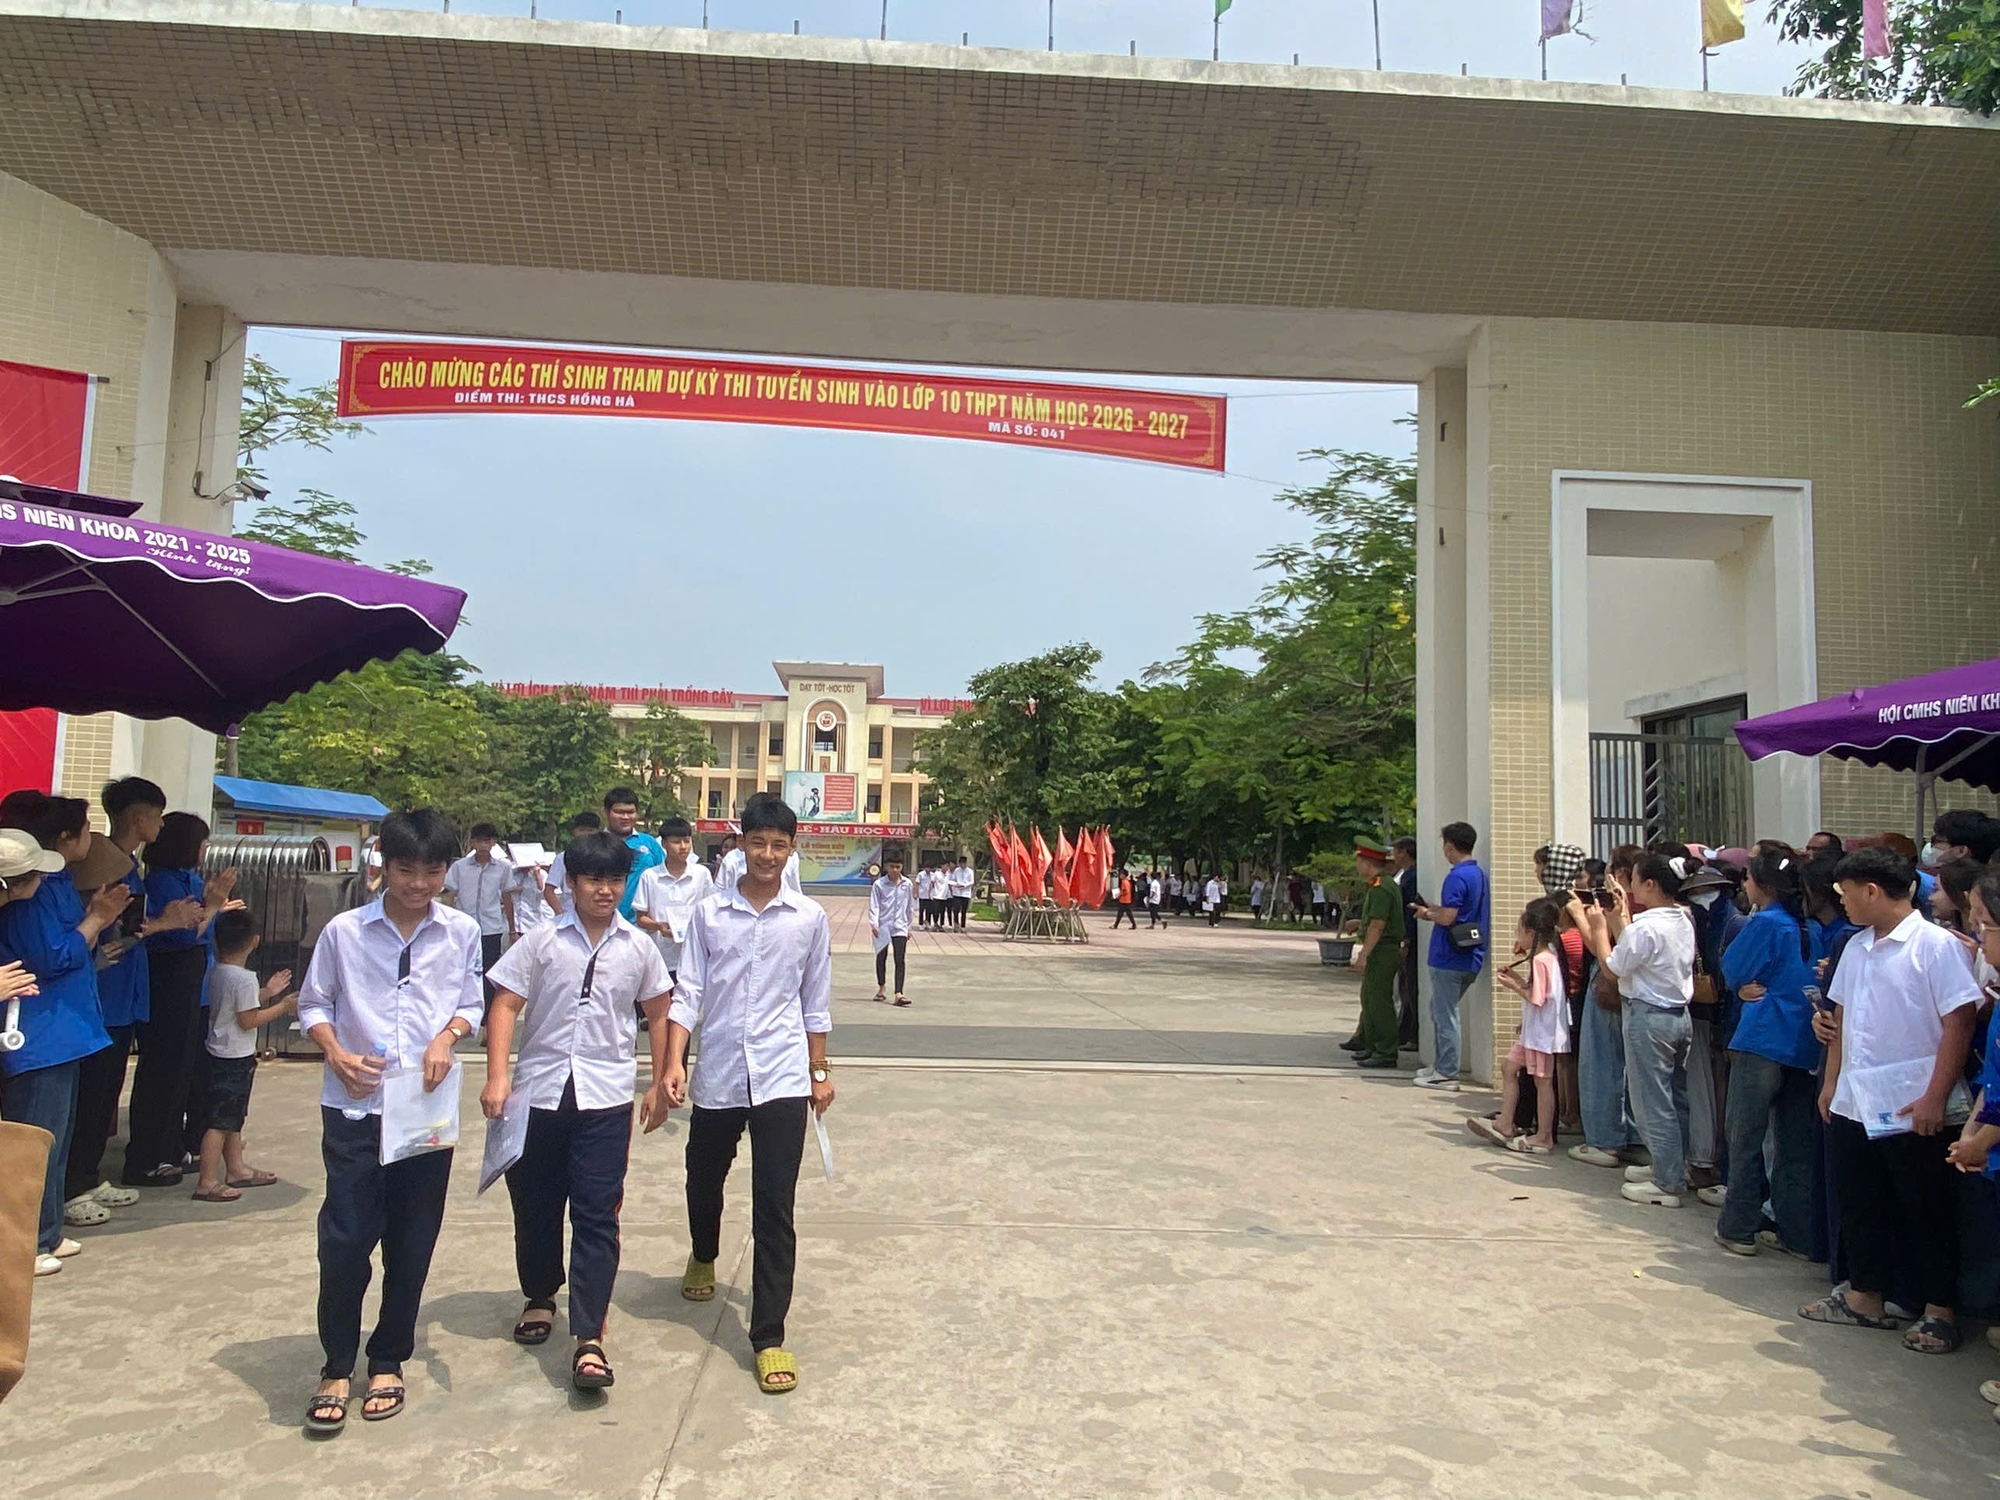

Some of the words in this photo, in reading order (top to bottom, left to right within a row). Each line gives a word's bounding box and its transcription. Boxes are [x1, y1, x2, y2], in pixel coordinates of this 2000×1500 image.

[379, 356, 427, 389] CHÀO
[430, 356, 485, 389] MỪNG
[488, 358, 525, 388] CÁC
[530, 359, 561, 389] THÍ
[562, 363, 608, 390] SINH
[613, 367, 663, 393] THAM
[667, 368, 693, 400] DỰ
[695, 368, 719, 396] KỲ
[724, 373, 751, 398] THI
[756, 370, 813, 402] TUYỂN
[817, 379, 860, 405] SINH
[864, 380, 898, 409] VÀO
[902, 382, 935, 411] LỚP
[940, 390, 961, 414] 10
[965, 391, 1007, 418] THPT
[1011, 393, 1050, 422] NĂM
[1055, 400, 1089, 430] HỌC
[1093, 404, 1134, 432] 2026
[1148, 410, 1189, 440] 2027
[455, 389, 492, 404] ĐIỂM
[496, 392, 524, 404] THI:
[529, 393, 566, 405] THCS
[1014, 422, 1038, 437] SỐ:
[1041, 427, 1065, 440] 041
[143, 530, 188, 551] 2021
[205, 541, 251, 565] 2025
[1878, 704, 1900, 724] HỘI
[1903, 700, 1941, 720] CMHS
[1945, 694, 1978, 715] NIÊN
